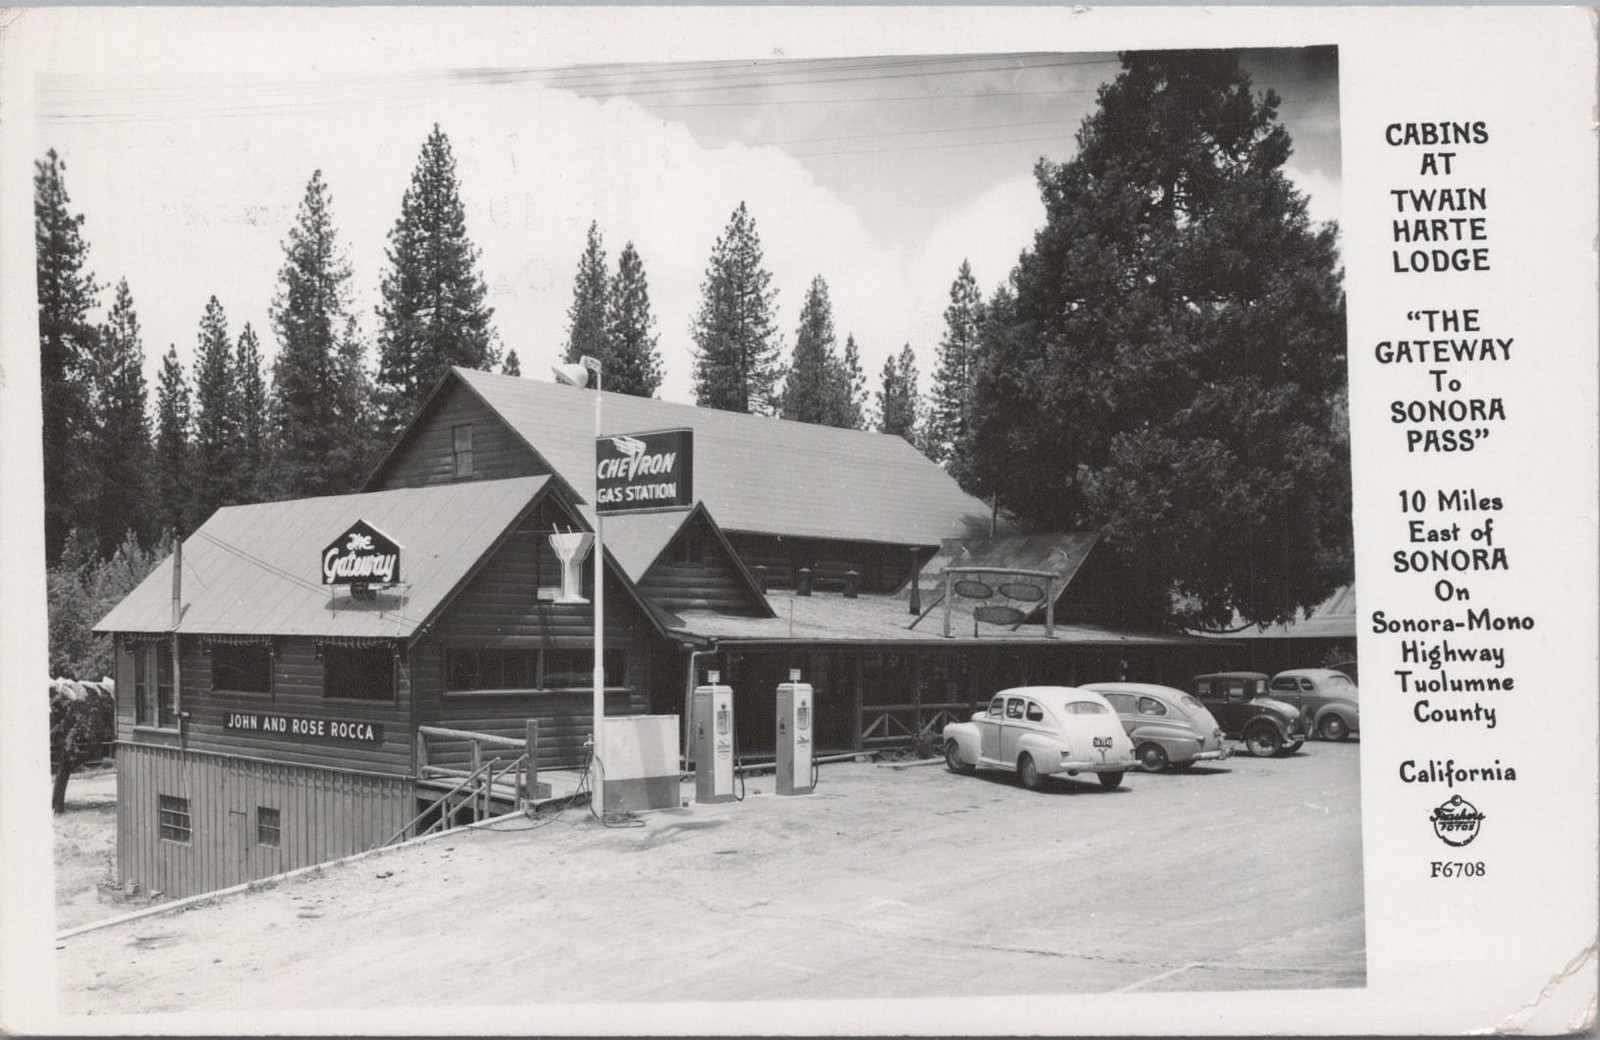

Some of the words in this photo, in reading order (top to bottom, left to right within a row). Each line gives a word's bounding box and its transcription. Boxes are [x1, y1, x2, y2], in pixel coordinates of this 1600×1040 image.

[597, 443, 676, 481] CHEVRON
[597, 487, 623, 503] GAS
[625, 482, 677, 501] STATION
[323, 547, 397, 584] Gateway
[228, 713, 258, 729] JOHN
[263, 716, 287, 732] AND
[292, 718, 325, 736] ROSE
[331, 721, 374, 740] ROCCA
